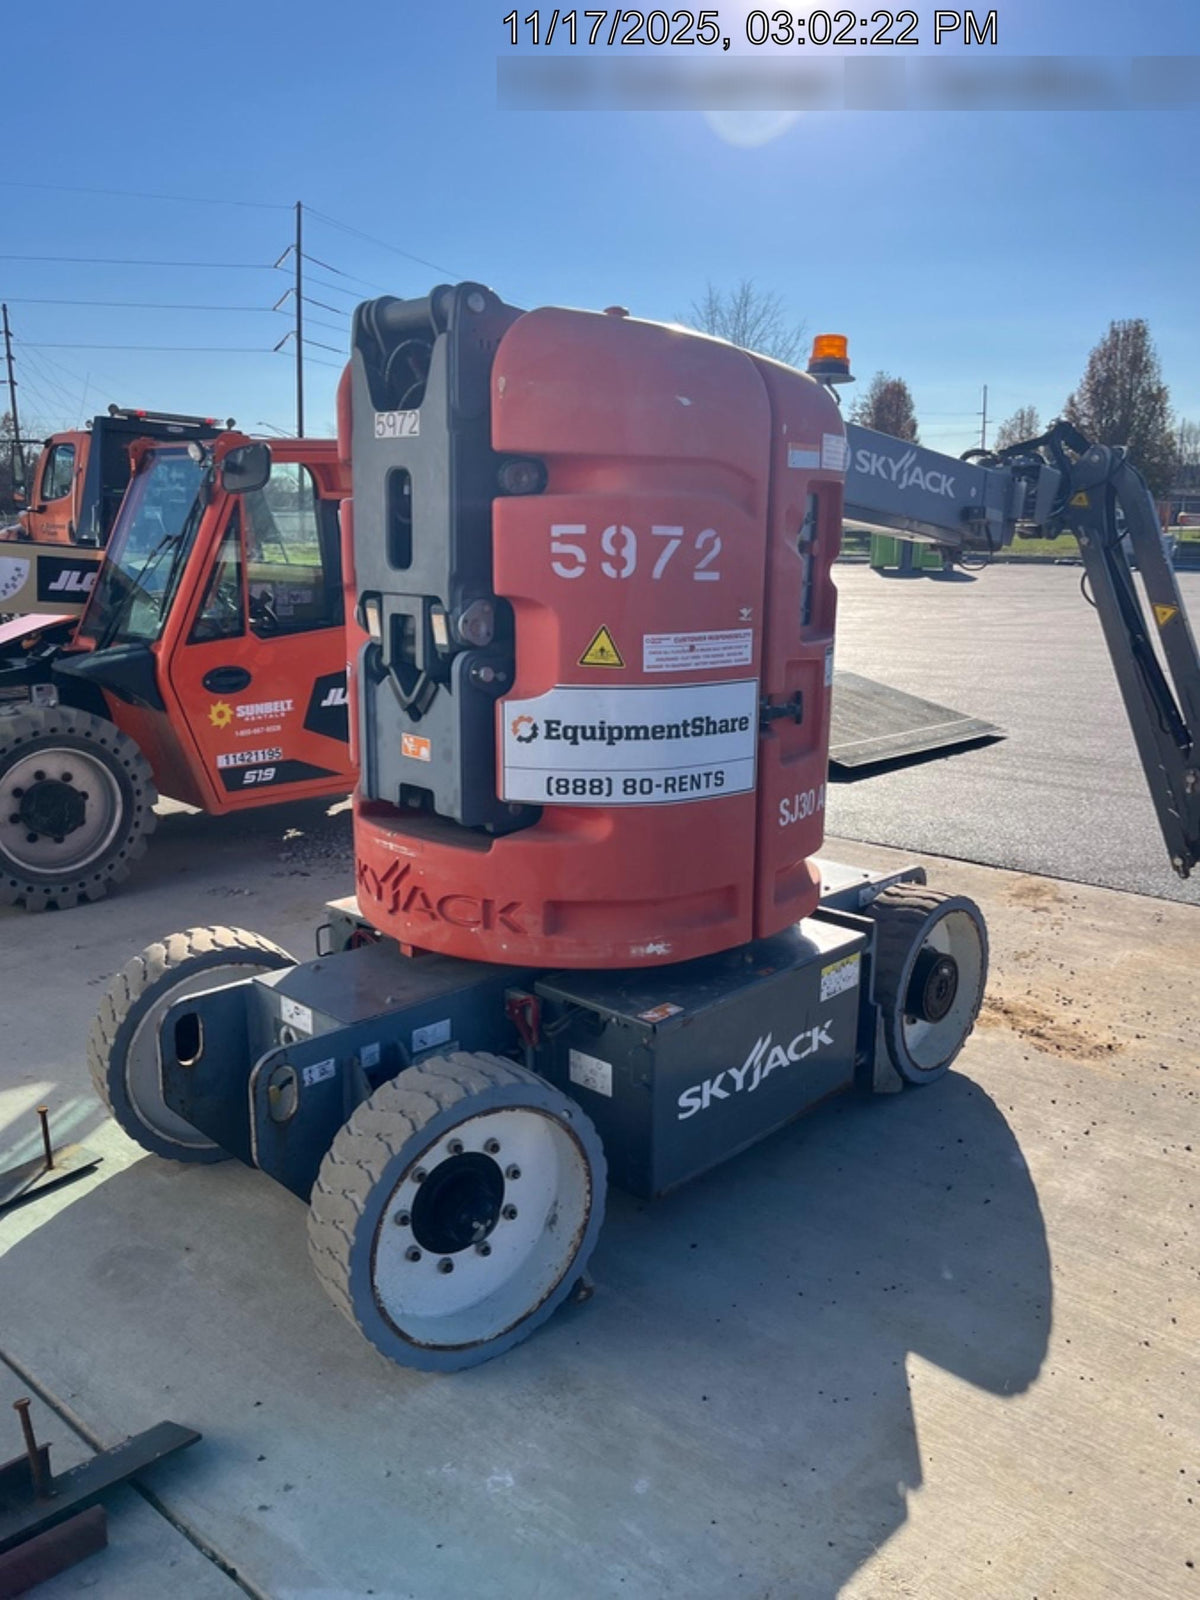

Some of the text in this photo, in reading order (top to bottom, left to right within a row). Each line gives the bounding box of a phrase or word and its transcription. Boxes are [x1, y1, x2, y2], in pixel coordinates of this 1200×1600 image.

[376, 411, 418, 436] 5972
[855, 449, 956, 498] SKYJACK
[550, 524, 722, 581] 5972
[236, 699, 294, 718] SUNBELT
[321, 687, 347, 707] JL
[544, 714, 750, 746] EquipmentShare
[224, 748, 282, 765] 11421195
[546, 770, 725, 797] (888) 80-RENTS
[779, 788, 816, 827] SJ30
[357, 858, 528, 935] KYJACK
[677, 1018, 834, 1121] SKYJACK
